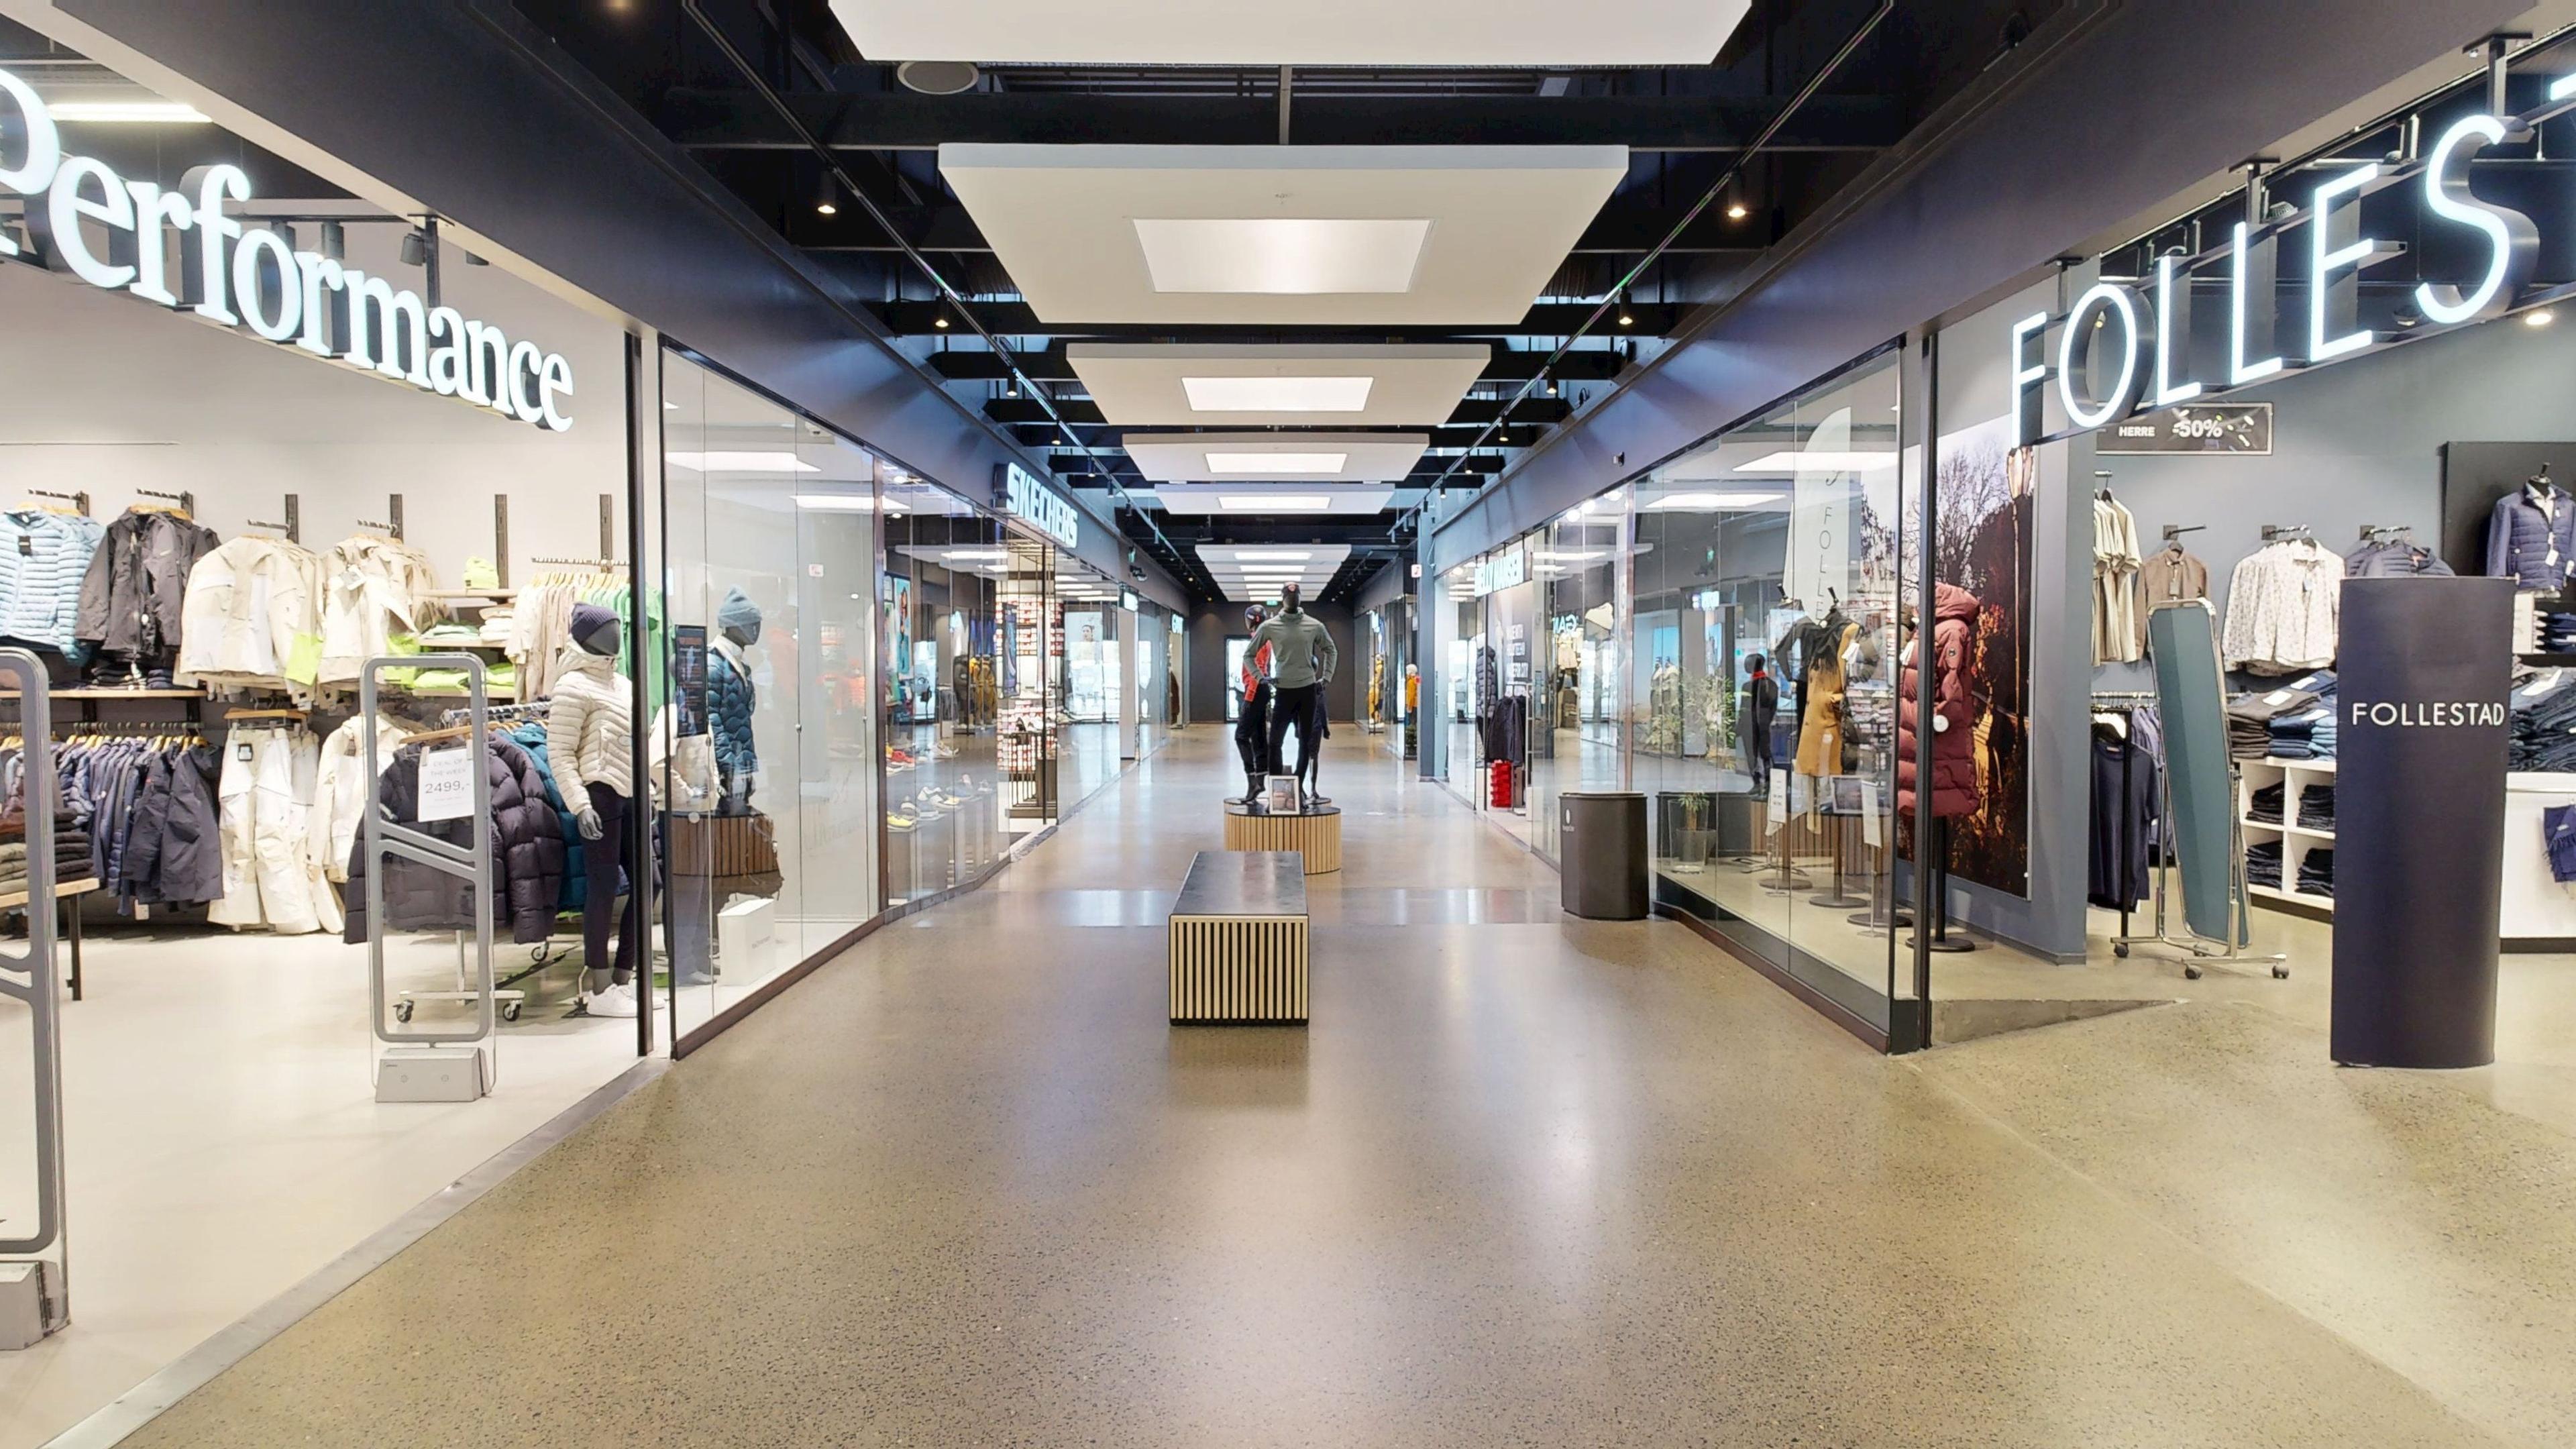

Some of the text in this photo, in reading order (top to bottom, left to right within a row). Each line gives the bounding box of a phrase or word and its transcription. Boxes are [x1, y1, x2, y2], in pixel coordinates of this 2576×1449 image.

[2011, 72, 2576, 448] FOLLES
[2118, 419, 2222, 438] HERRE -50%
[1006, 462, 1078, 548] SKECHERS
[2353, 702, 2505, 726] FOLLESTAD
[425, 780, 470, 794] 2499,-
